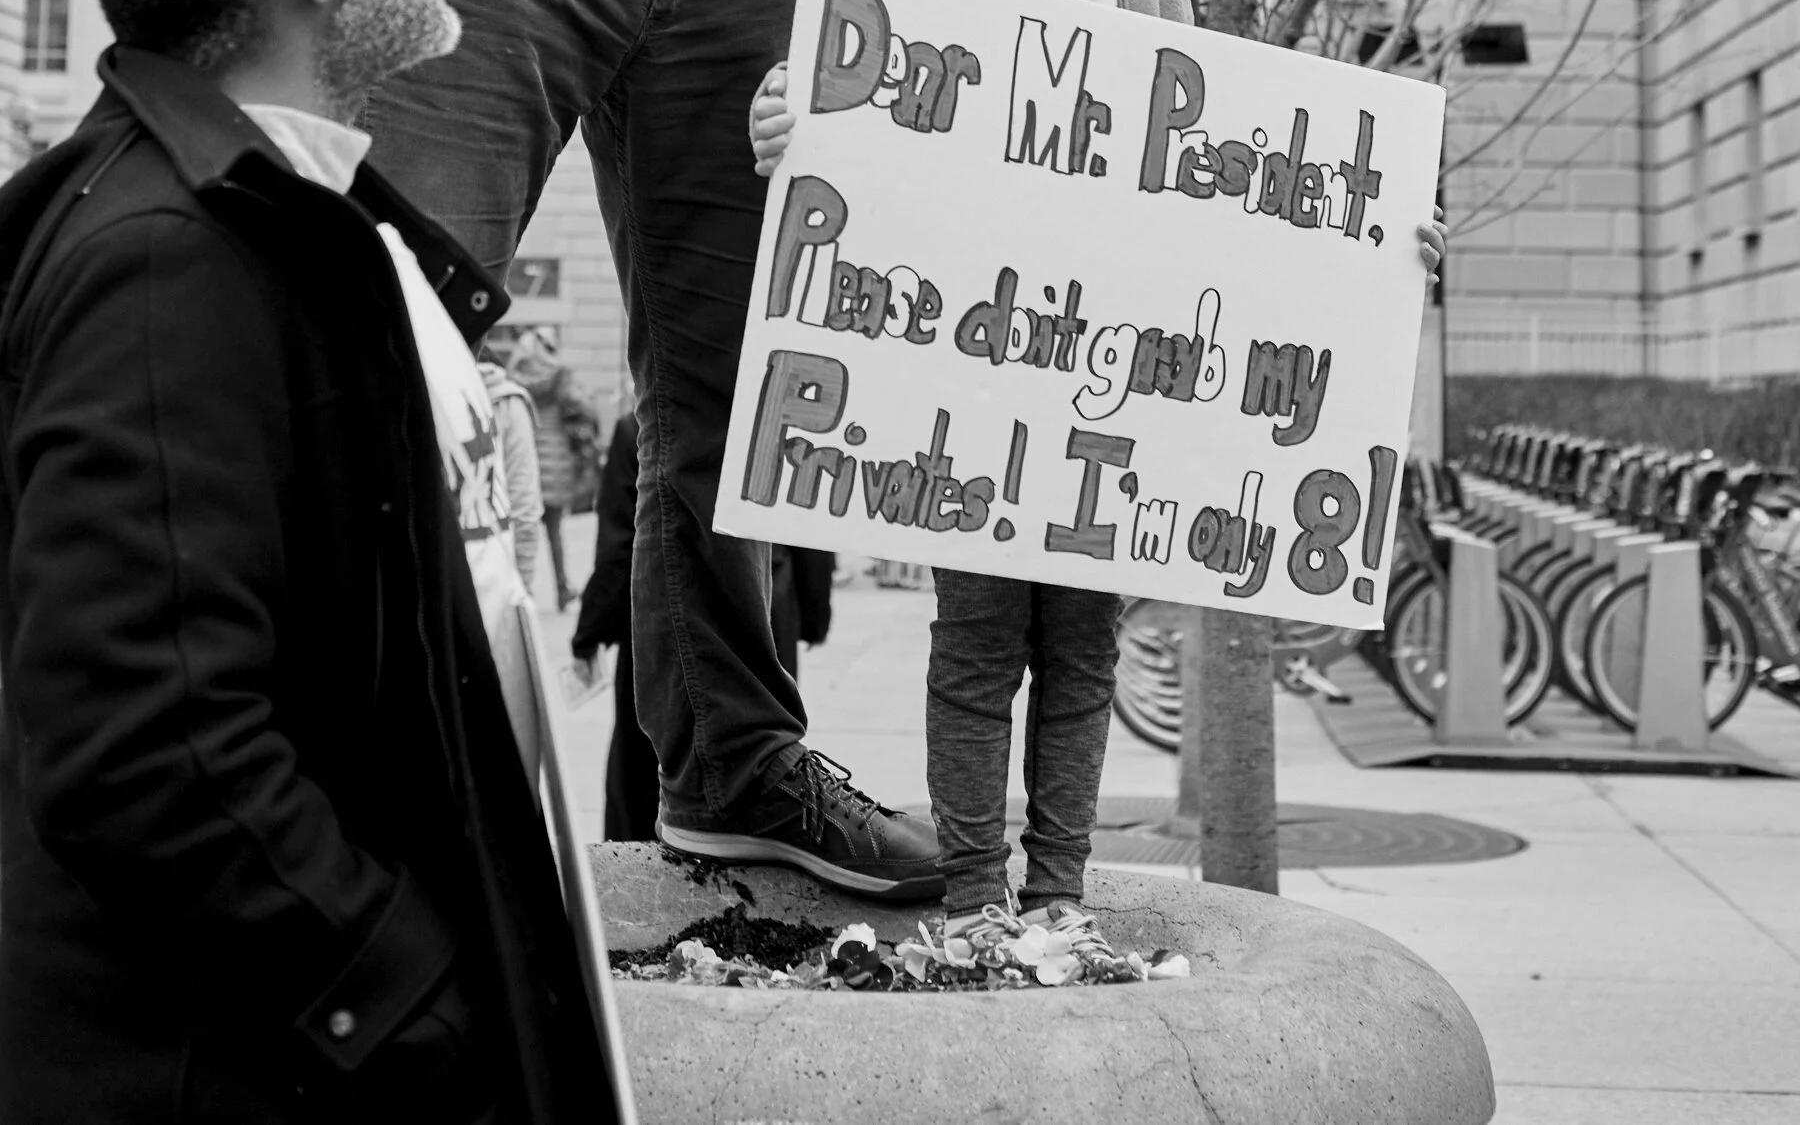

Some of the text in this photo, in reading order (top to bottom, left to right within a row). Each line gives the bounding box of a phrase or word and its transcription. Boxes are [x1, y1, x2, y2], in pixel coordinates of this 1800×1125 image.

[1004, 15, 1112, 177] Mr.
[1138, 47, 1385, 247] President,
[765, 174, 1332, 446] Please don't grab my
[740, 349, 1399, 606] Privates! I'm only 8!
